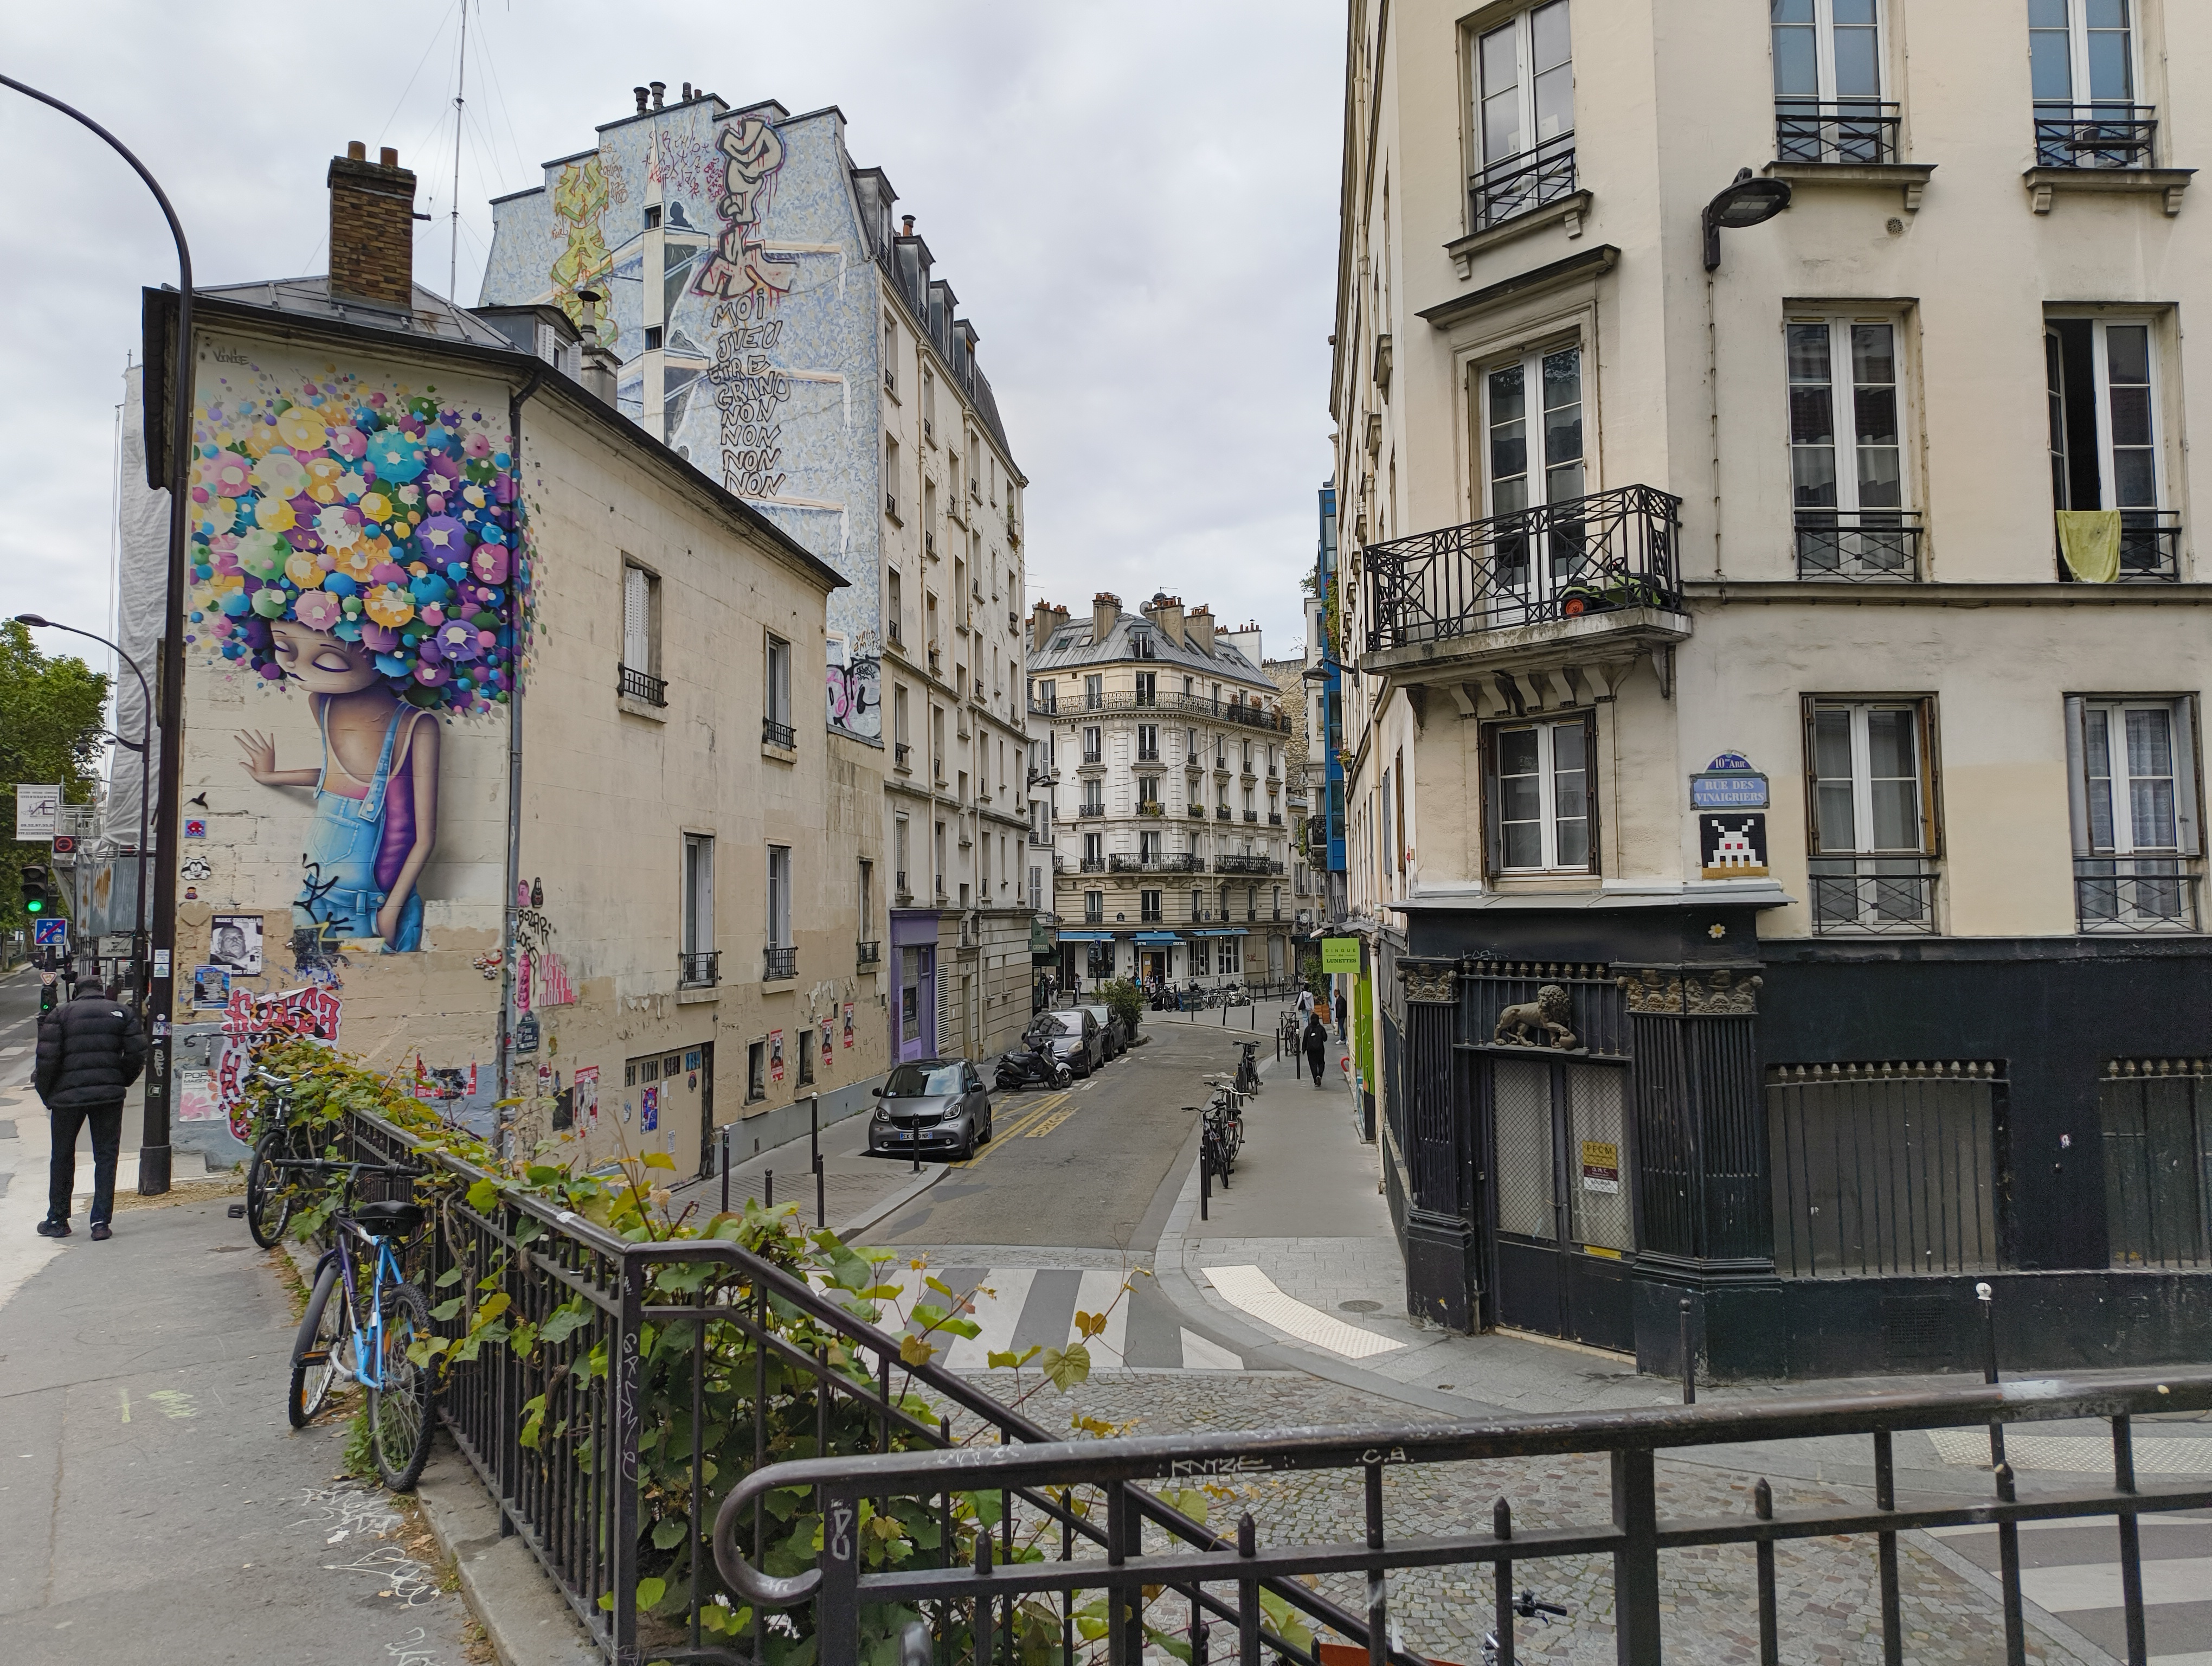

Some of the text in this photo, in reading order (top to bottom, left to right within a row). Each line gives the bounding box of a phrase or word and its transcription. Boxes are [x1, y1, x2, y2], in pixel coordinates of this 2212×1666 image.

[716, 321, 783, 363] JVEU
[707, 354, 771, 386] ETRE
[721, 395, 777, 427] NON
[721, 424, 782, 450] NON
[722, 448, 782, 472] NON
[724, 469, 786, 499] NON
[1695, 792, 1765, 802] VINAIGRIERS
[1705, 780, 1754, 790] RUE DES
[541, 954, 561, 967] NAN
